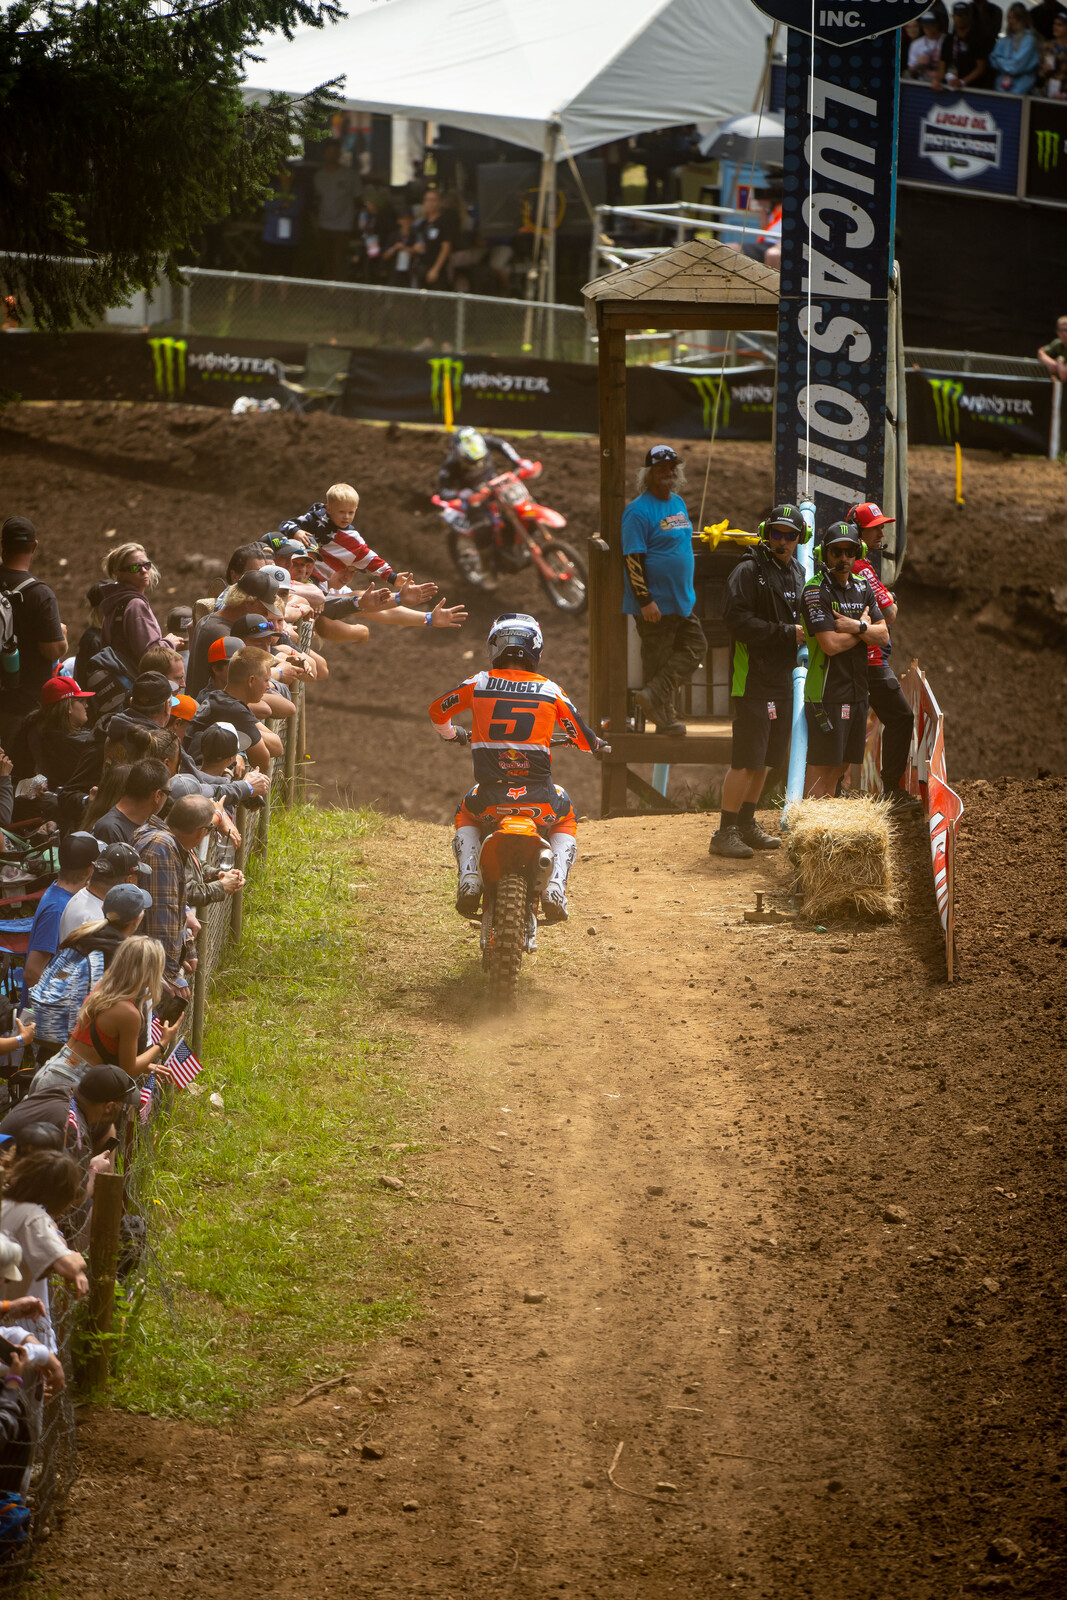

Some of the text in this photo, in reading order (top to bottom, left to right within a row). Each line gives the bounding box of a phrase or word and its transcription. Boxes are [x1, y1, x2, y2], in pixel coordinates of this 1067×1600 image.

[819, 10, 866, 28] INC.
[935, 113, 987, 131] LUCAS OIL
[797, 74, 878, 363] LUCAS
[188, 352, 276, 374] MONSTER
[463, 371, 550, 393] MONSTER
[731, 384, 774, 403] MONS
[960, 394, 1034, 416] MONSTER
[796, 383, 871, 507] OIL
[486, 677, 544, 694] DUNGEY
[441, 694, 460, 713] KTM
[488, 699, 540, 742] 5
[560, 718, 578, 740] KTM
